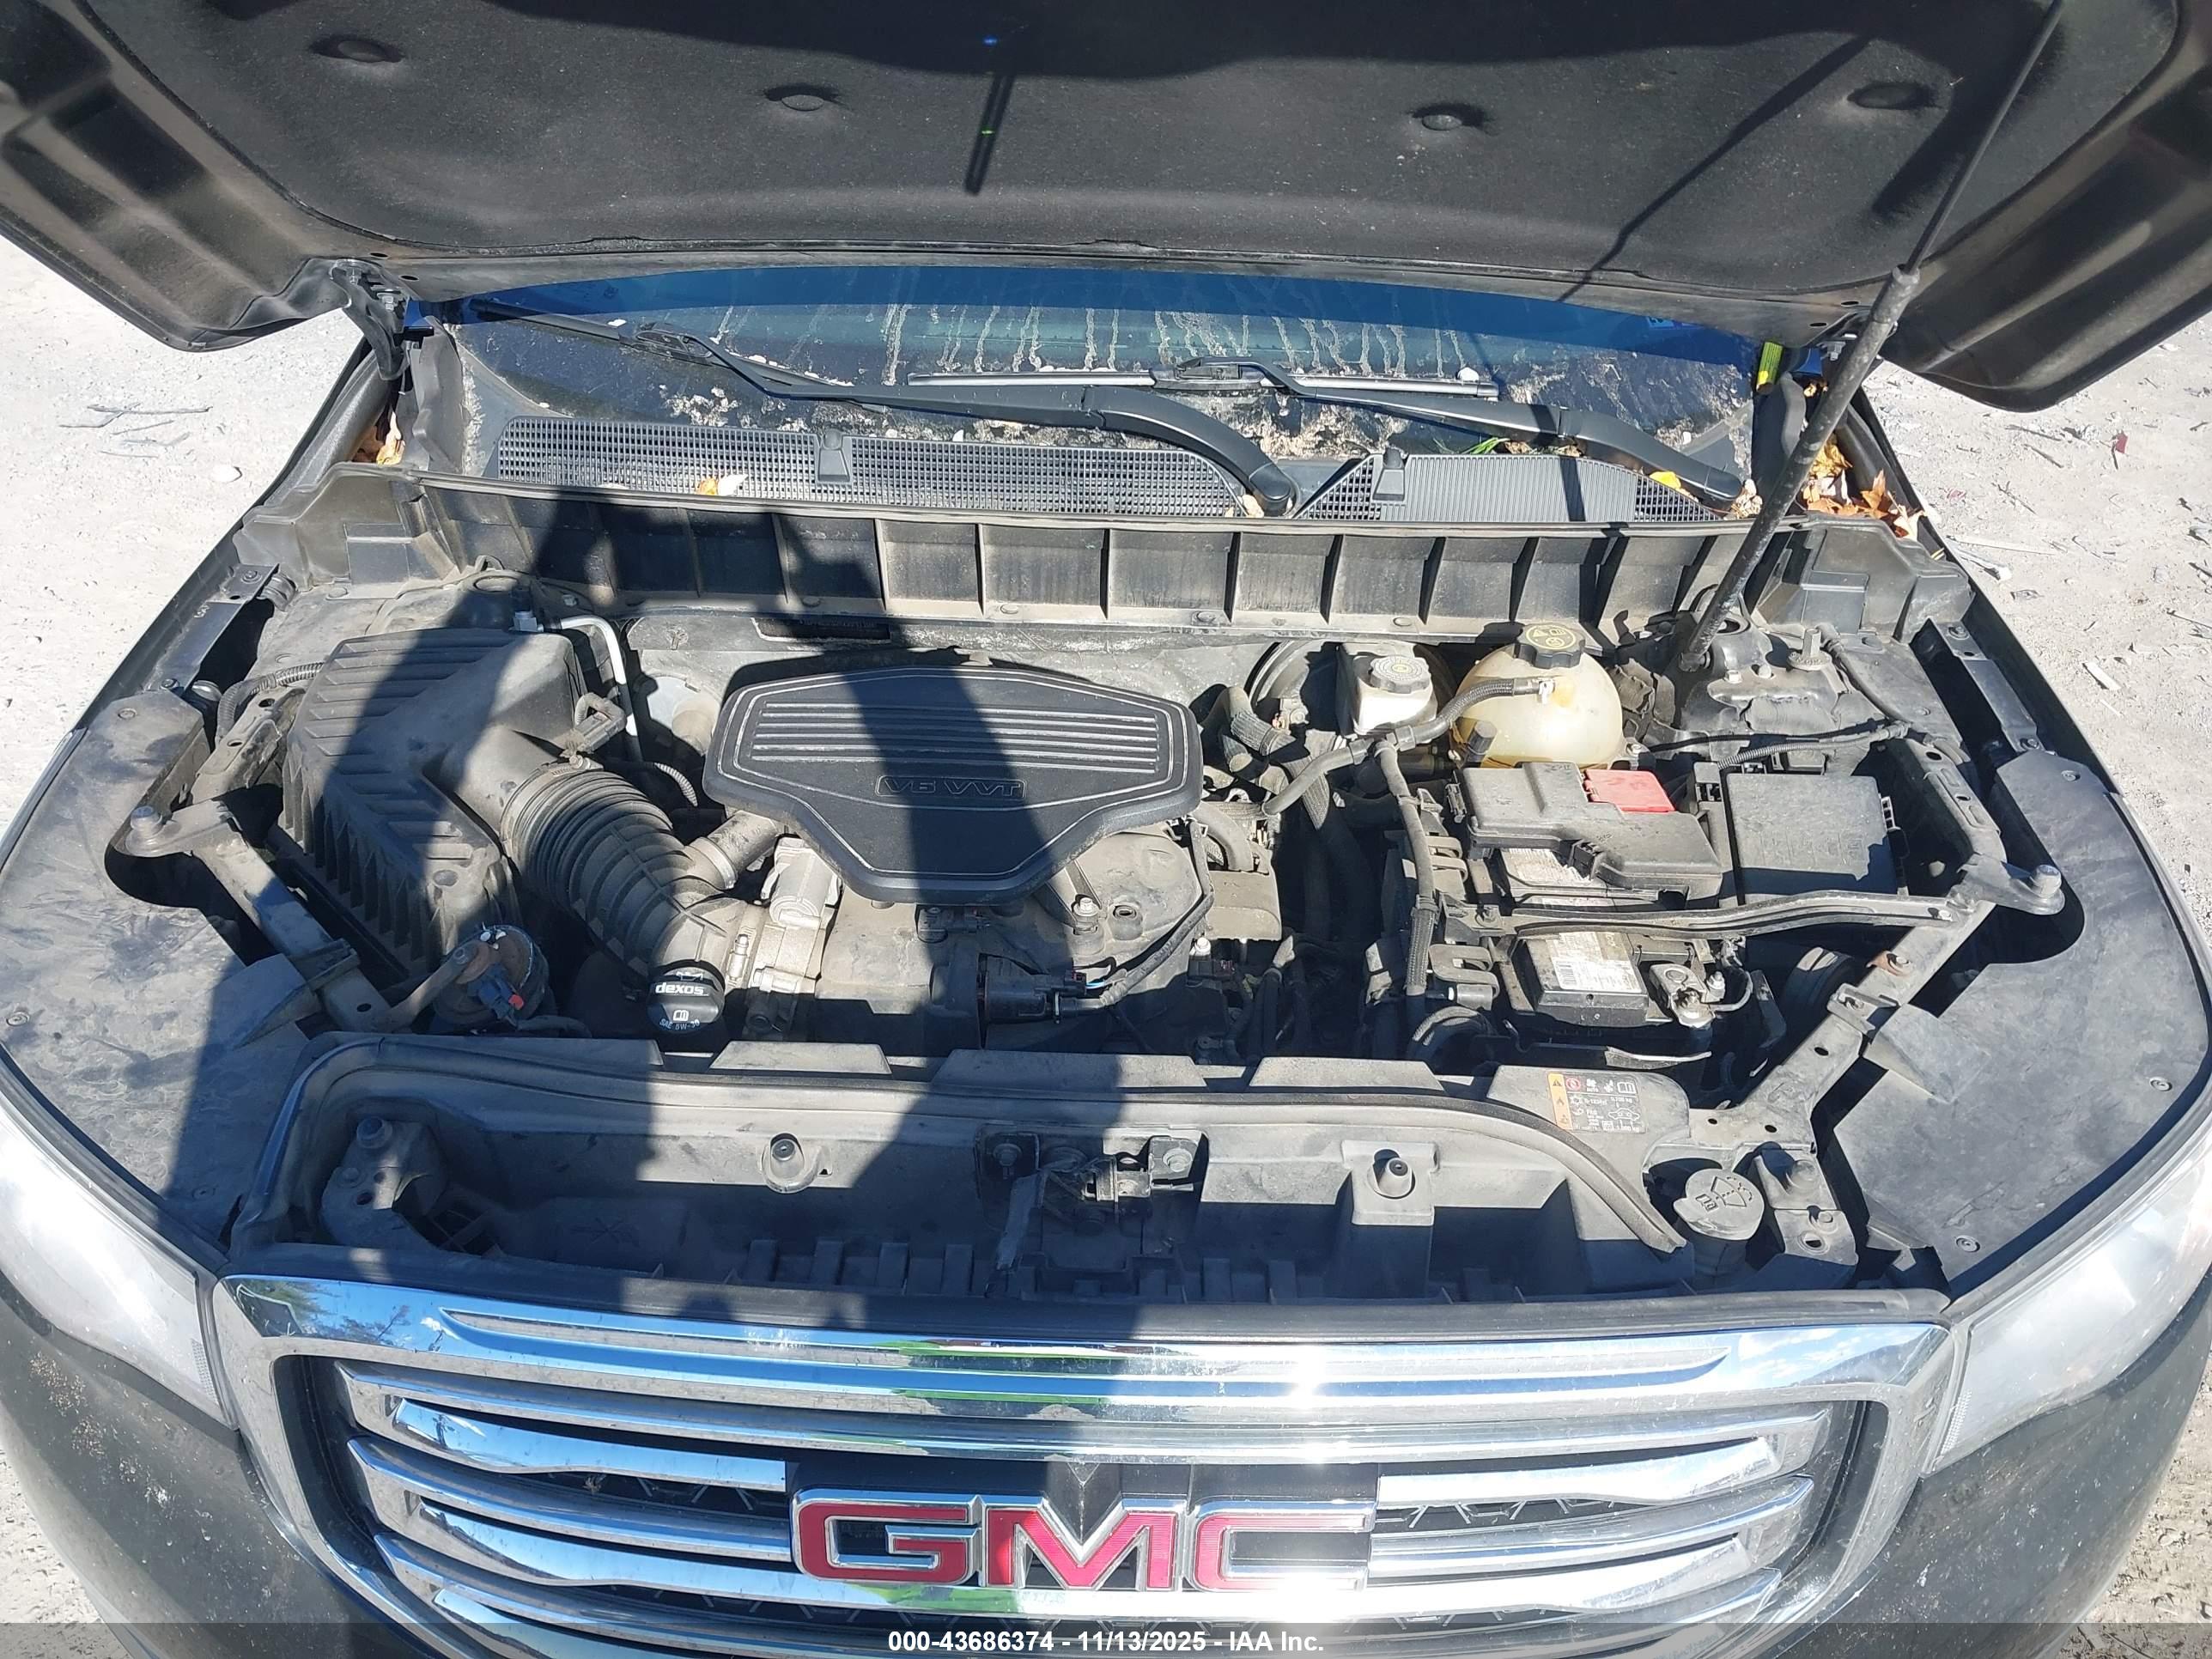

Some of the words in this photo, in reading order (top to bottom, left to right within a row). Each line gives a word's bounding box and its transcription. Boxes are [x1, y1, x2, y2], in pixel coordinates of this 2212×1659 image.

[884, 777, 936, 794] V6
[943, 779, 1021, 796] VVT
[655, 982, 704, 995] dexos
[659, 1018, 672, 1030] SAE
[791, 1487, 1377, 1593] GMC
